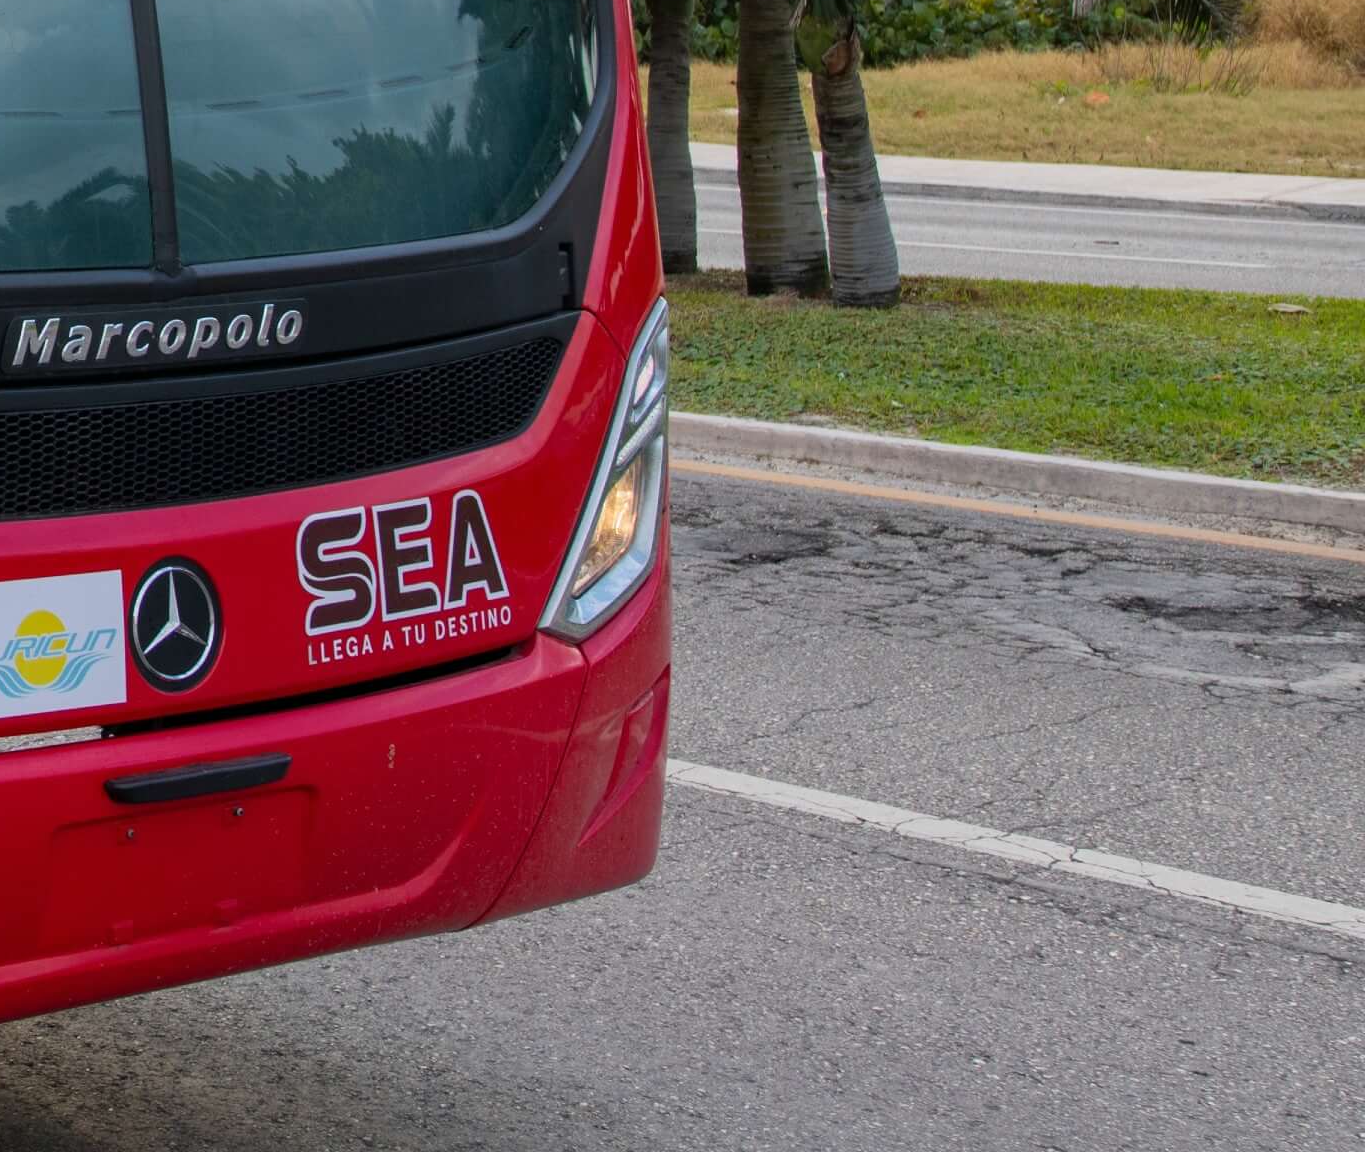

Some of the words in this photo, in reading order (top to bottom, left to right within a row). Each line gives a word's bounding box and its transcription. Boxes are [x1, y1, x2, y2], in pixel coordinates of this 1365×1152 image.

[12, 303, 303, 367] Marcopolo
[296, 489, 510, 636] SEA
[308, 634, 373, 665] LLEGA
[382, 630, 394, 651] A
[402, 623, 426, 647] TU
[435, 605, 511, 641] DESTINO
